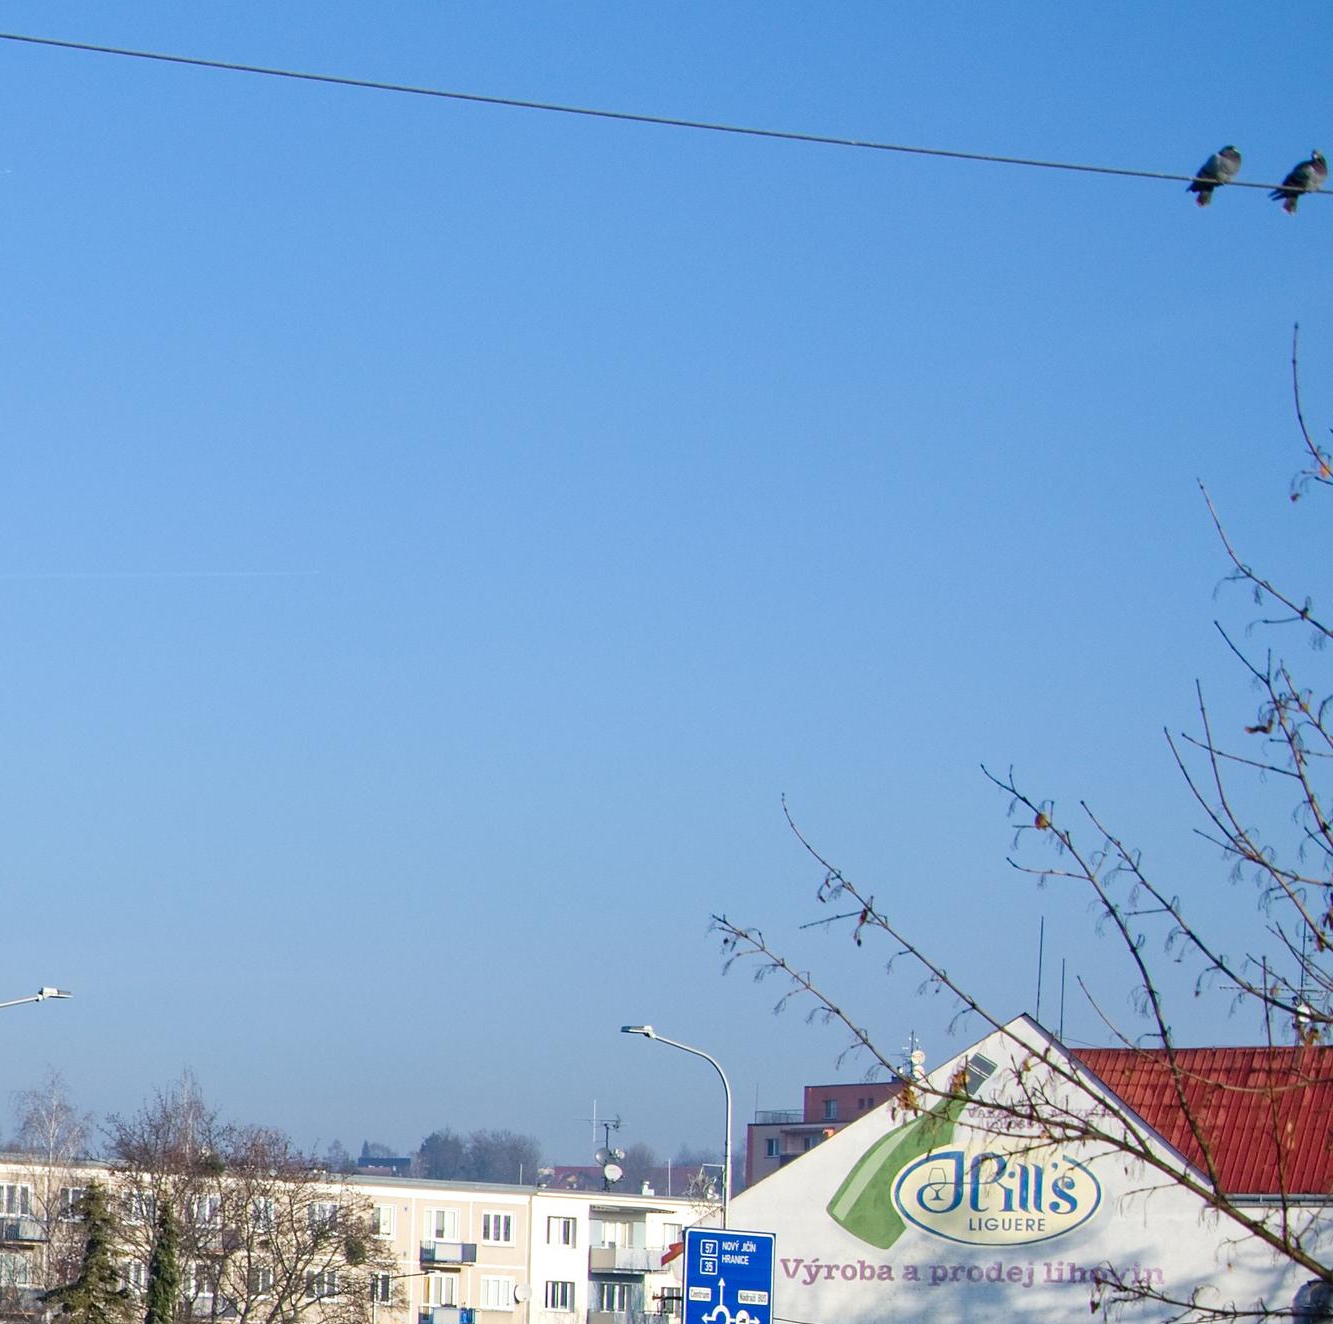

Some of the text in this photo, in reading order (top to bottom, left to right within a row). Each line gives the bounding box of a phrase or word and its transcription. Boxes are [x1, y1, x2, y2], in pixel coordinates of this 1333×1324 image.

[969, 1218, 1046, 1231] LIGUERE
[705, 1243, 714, 1253] 57
[722, 1240, 757, 1253] NOVÝ JIČÍN
[721, 1254, 749, 1265] HRANICE
[704, 1262, 713, 1271] 35
[779, 1258, 1165, 1288] Výroba a prodej lihovin
